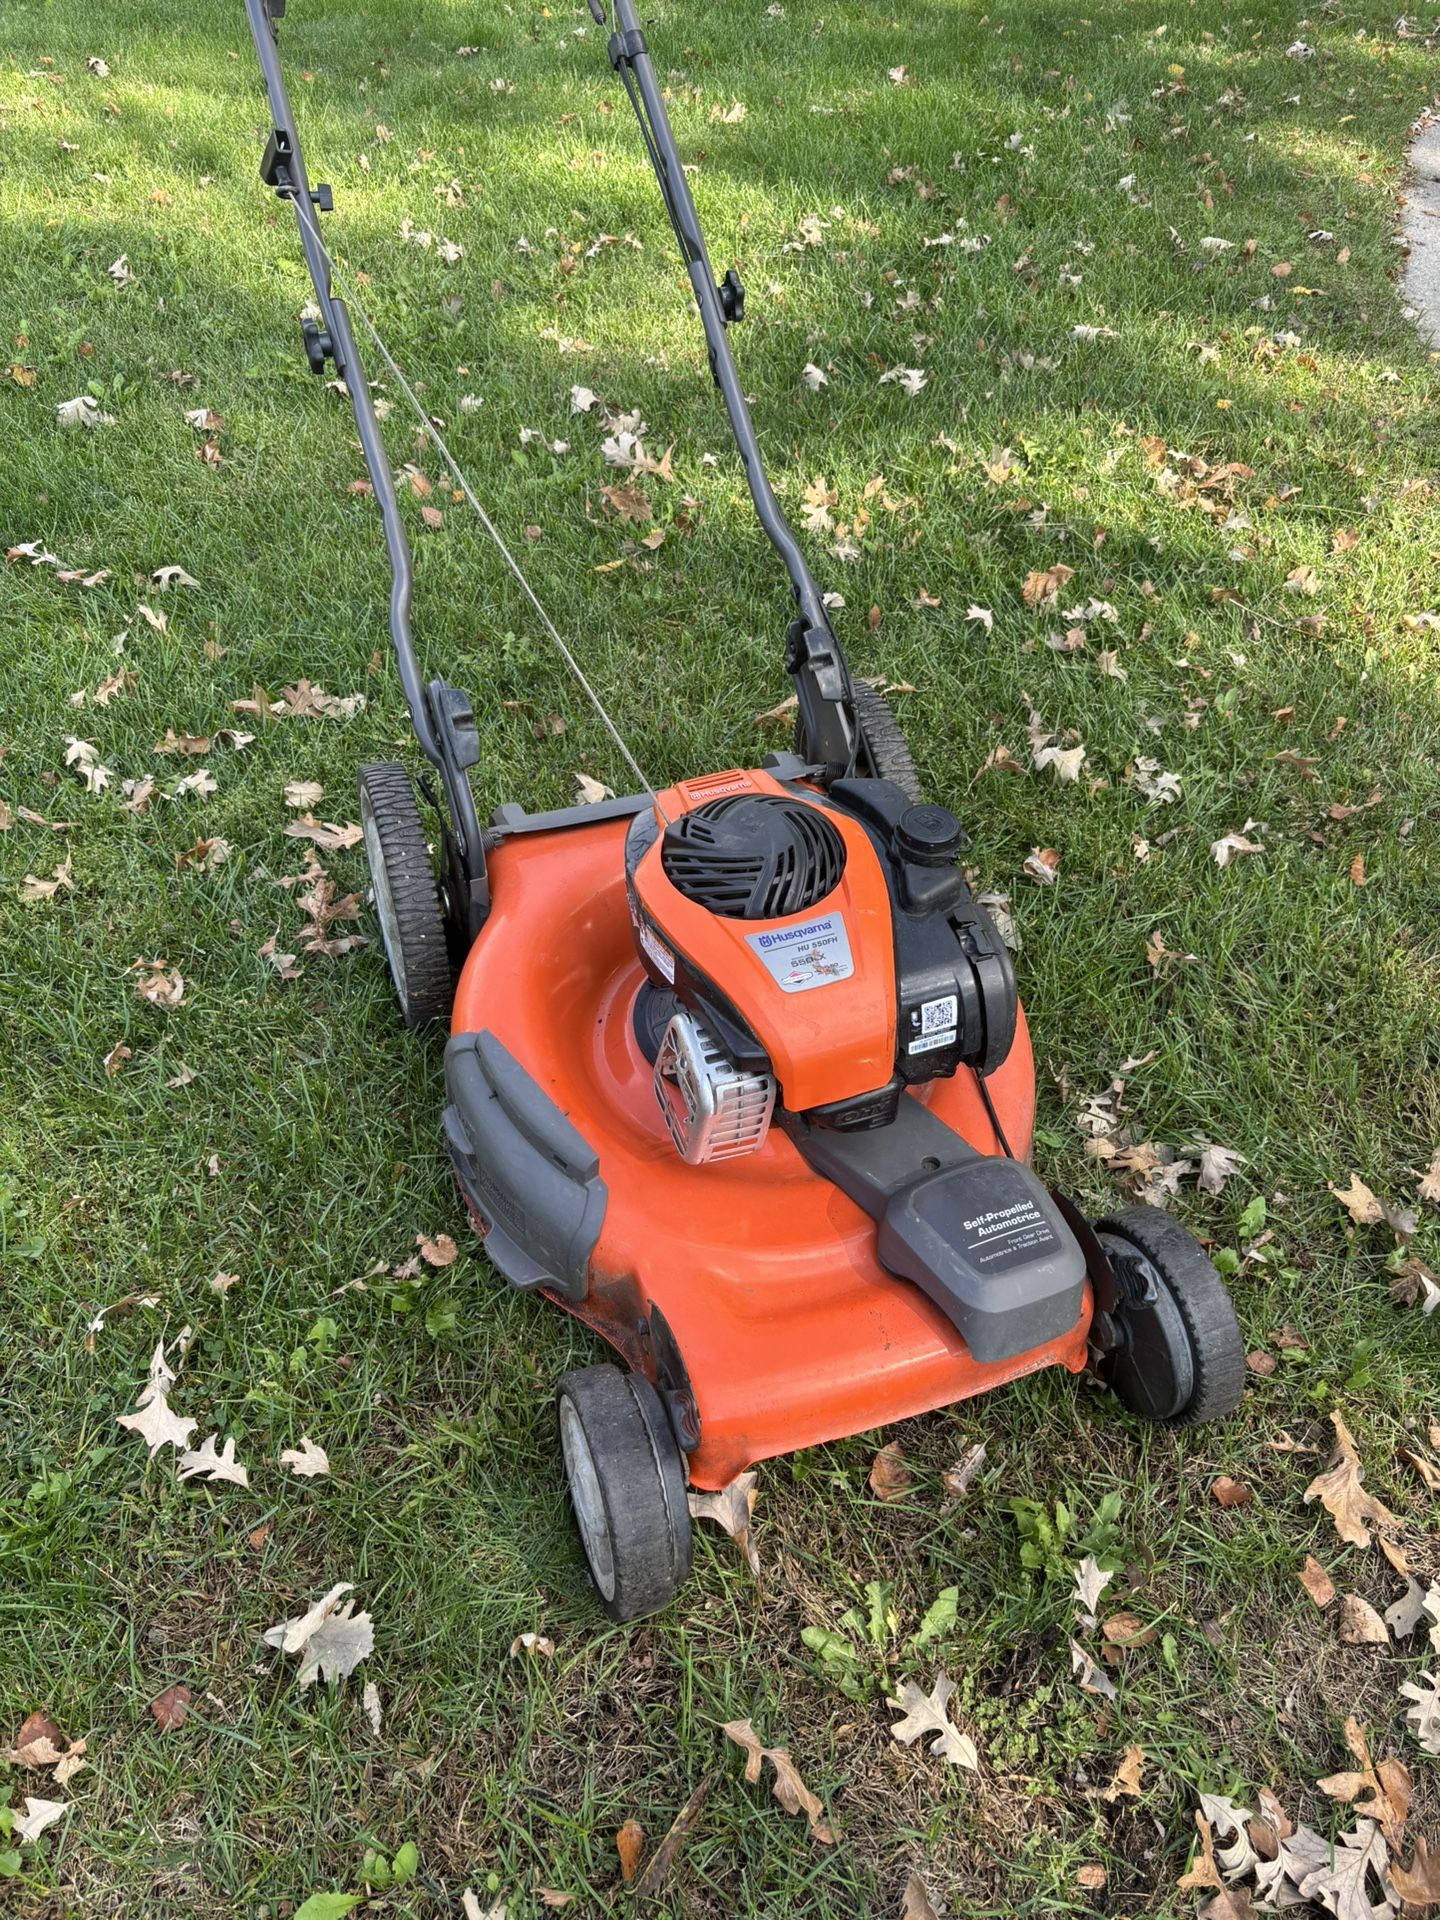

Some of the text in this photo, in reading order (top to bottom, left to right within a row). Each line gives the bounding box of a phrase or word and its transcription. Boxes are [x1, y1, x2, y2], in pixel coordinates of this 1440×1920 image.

[700, 781, 752, 799] Husqvarna
[770, 922, 832, 943] Husqvarna
[797, 936, 838, 953] HU 550FH
[790, 952, 826, 968] 550X
[963, 1200, 1034, 1231] Self-Propelled
[977, 1211, 1041, 1237] Automotrice
